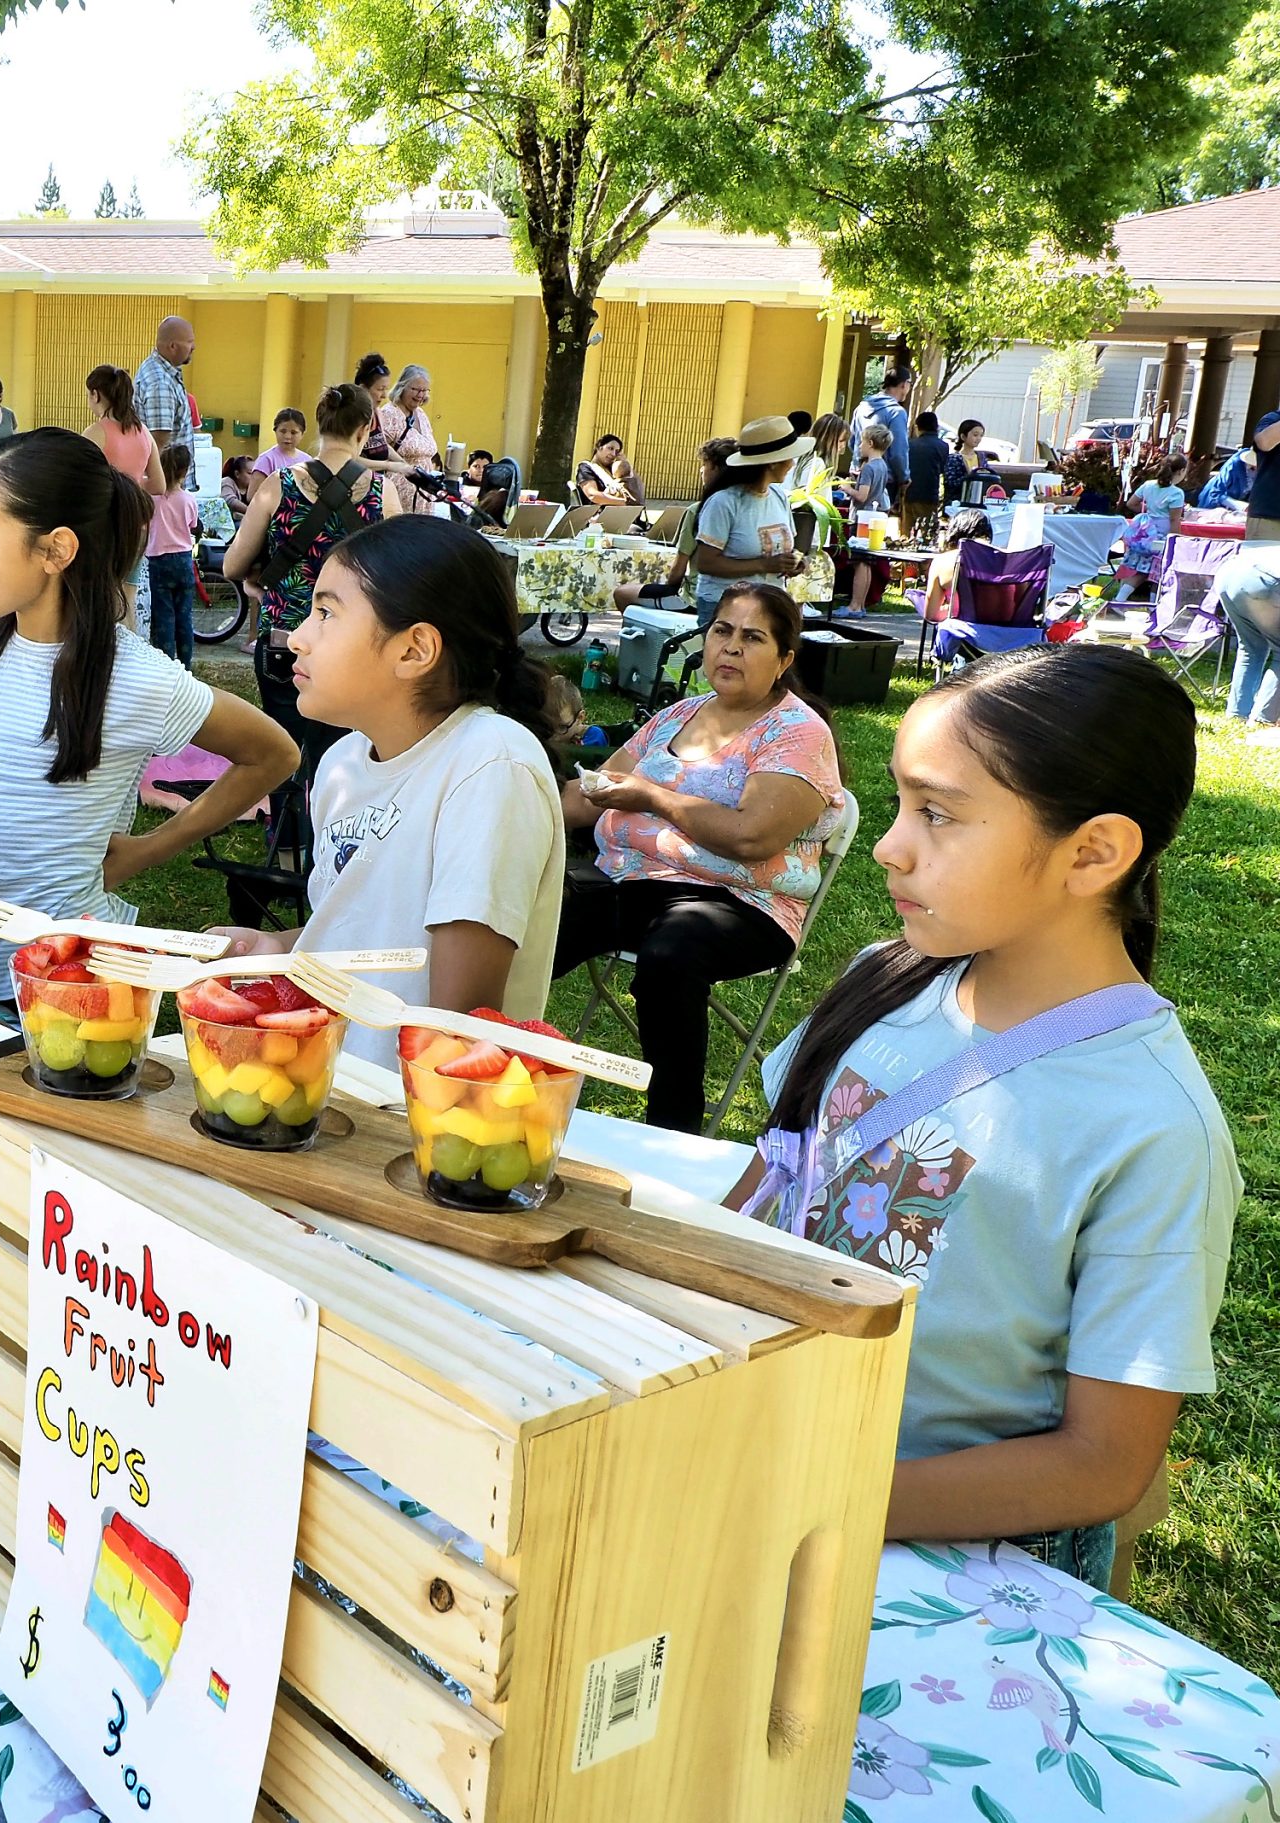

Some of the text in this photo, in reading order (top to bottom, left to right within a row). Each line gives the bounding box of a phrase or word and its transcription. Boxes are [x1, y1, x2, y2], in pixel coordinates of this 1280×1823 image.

[580, 1050, 639, 1072] FSC WORLD
[599, 1063, 641, 1080] CENTRIC
[42, 1190, 232, 1370] Rainbow
[63, 1296, 165, 1407] Fruit
[34, 1367, 151, 1507] Cups
[652, 1635, 666, 1670] MAKE
